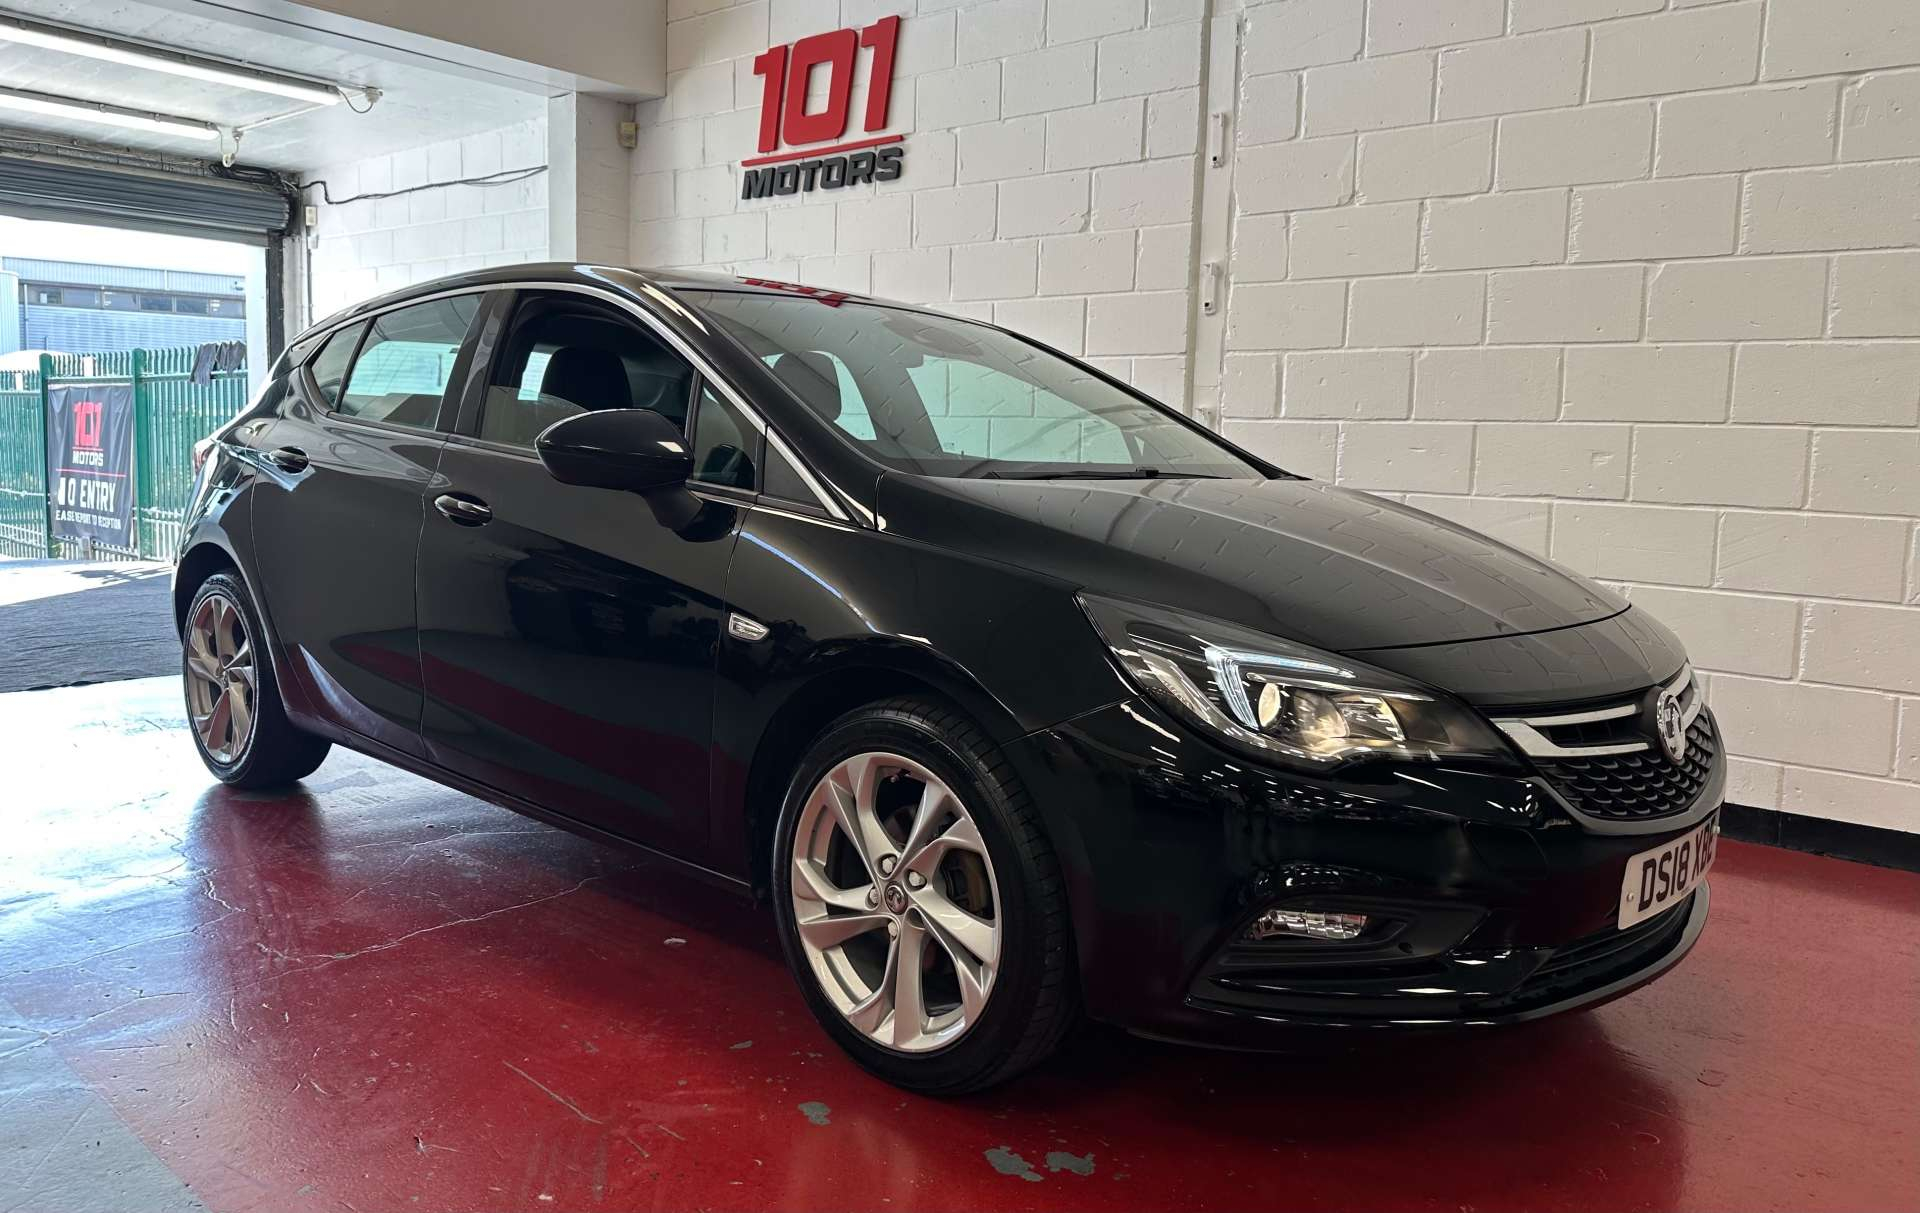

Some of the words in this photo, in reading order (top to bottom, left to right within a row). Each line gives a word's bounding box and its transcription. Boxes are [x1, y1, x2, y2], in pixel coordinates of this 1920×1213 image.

[753, 15, 900, 153] 101
[741, 147, 903, 200] MOTORS
[73, 402, 102, 447] 101
[72, 450, 104, 467] MOTORS
[80, 479, 116, 512] ENTRY
[1638, 840, 1690, 912] DS18
